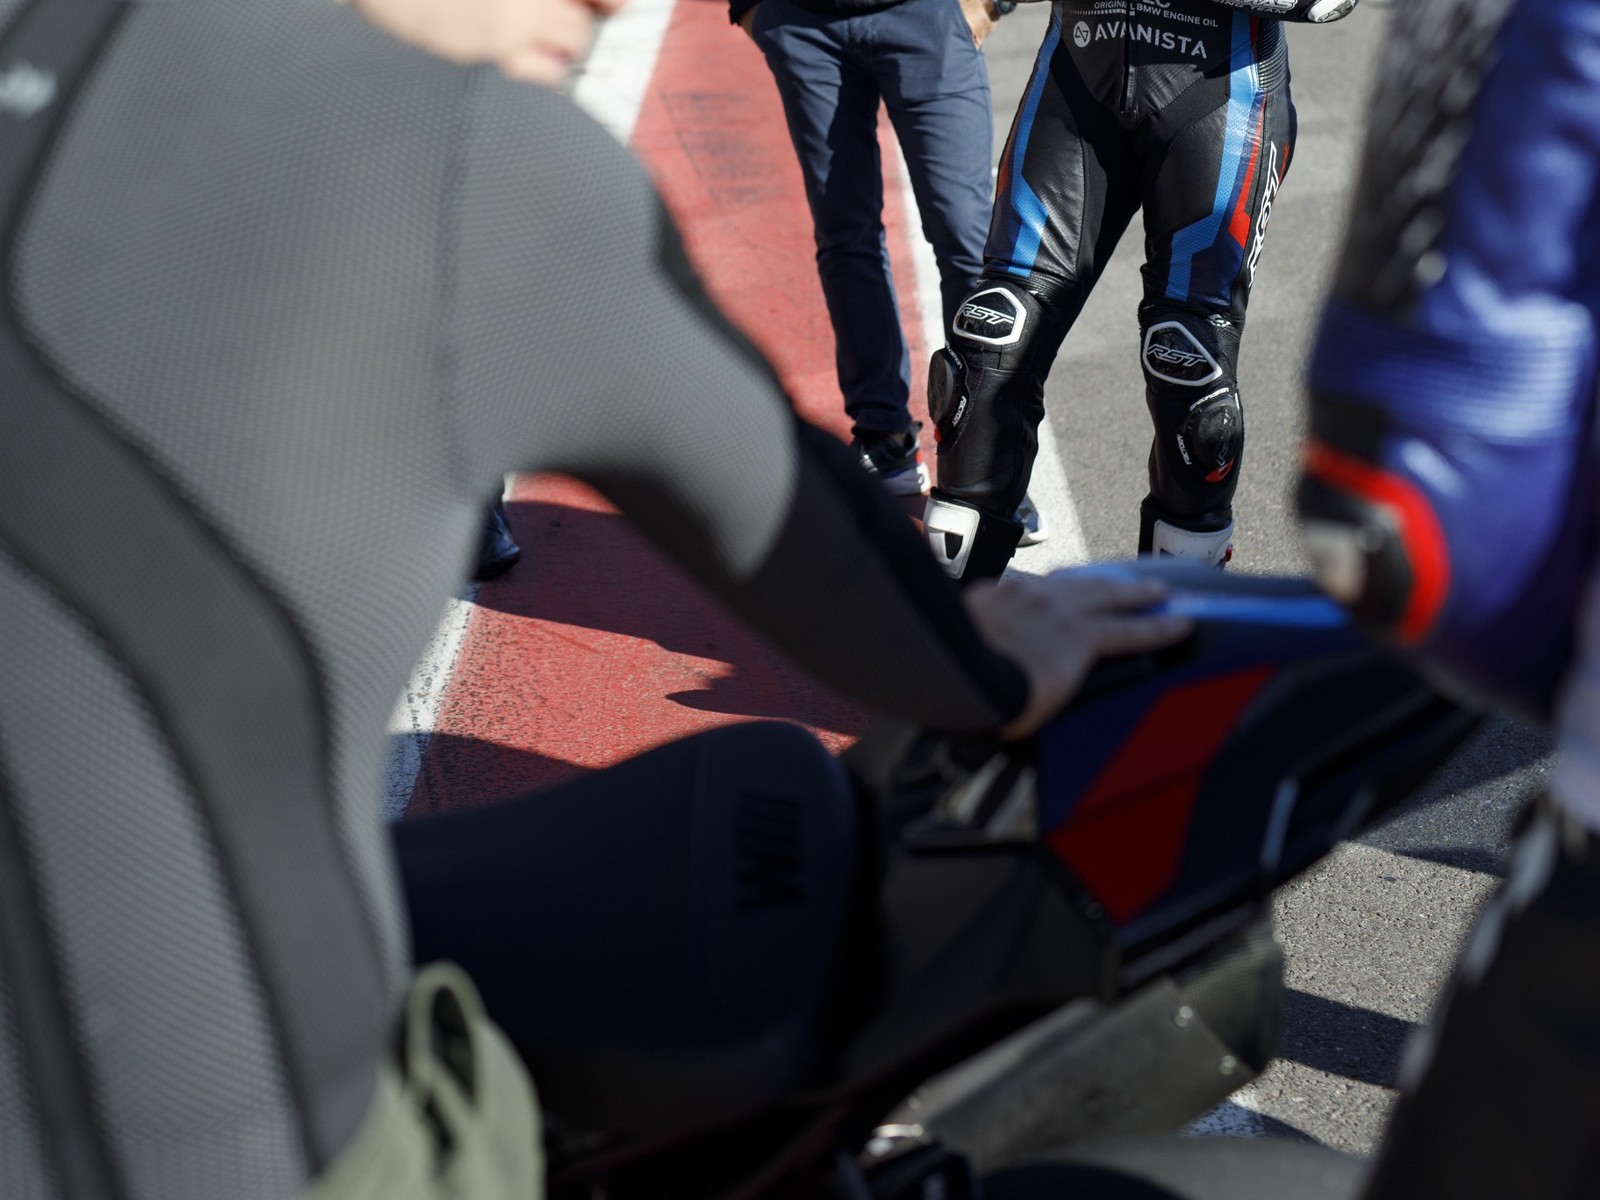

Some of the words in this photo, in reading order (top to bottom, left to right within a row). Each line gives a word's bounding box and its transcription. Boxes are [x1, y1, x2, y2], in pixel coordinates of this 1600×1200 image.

[1094, 0, 1135, 11] ORIGINAL
[1136, 3, 1161, 16] BMW
[1163, 10, 1200, 24] ENGINE
[1202, 17, 1219, 28] OIL
[1094, 20, 1207, 59] AVANISTA
[958, 303, 1015, 325] RST
[1147, 344, 1207, 367] RST
